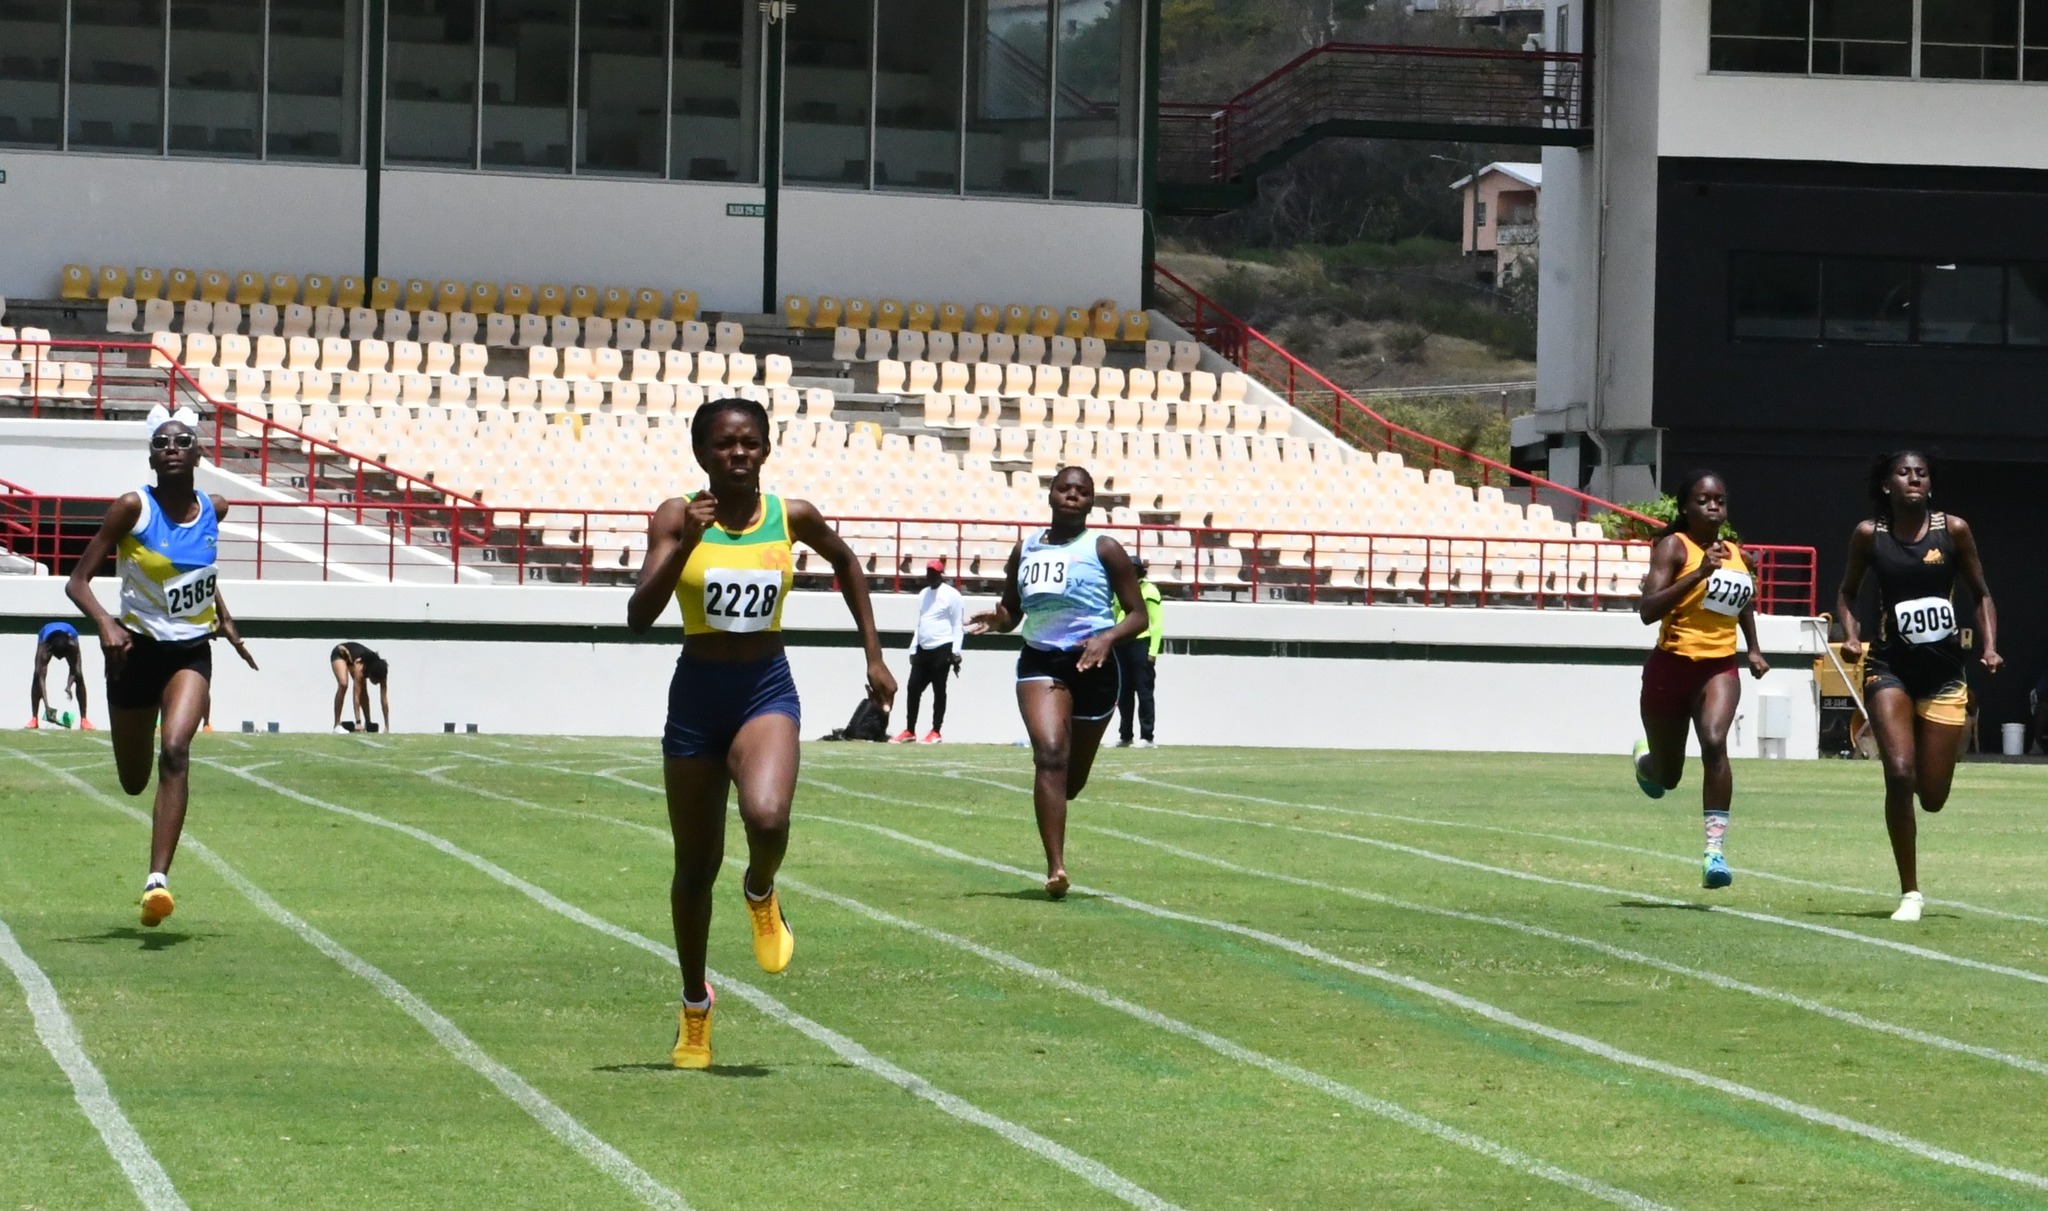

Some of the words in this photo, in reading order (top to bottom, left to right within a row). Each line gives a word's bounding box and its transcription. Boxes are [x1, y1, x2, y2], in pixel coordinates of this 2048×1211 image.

[486, 550, 492, 560] 3
[533, 568, 538, 579] 2
[1022, 562, 1064, 588] 2013
[168, 574, 217, 614] 2589
[706, 582, 778, 618] 2228
[1273, 588, 1279, 598] 2
[1707, 578, 1751, 608] 2738
[1901, 606, 1952, 635] 2909
